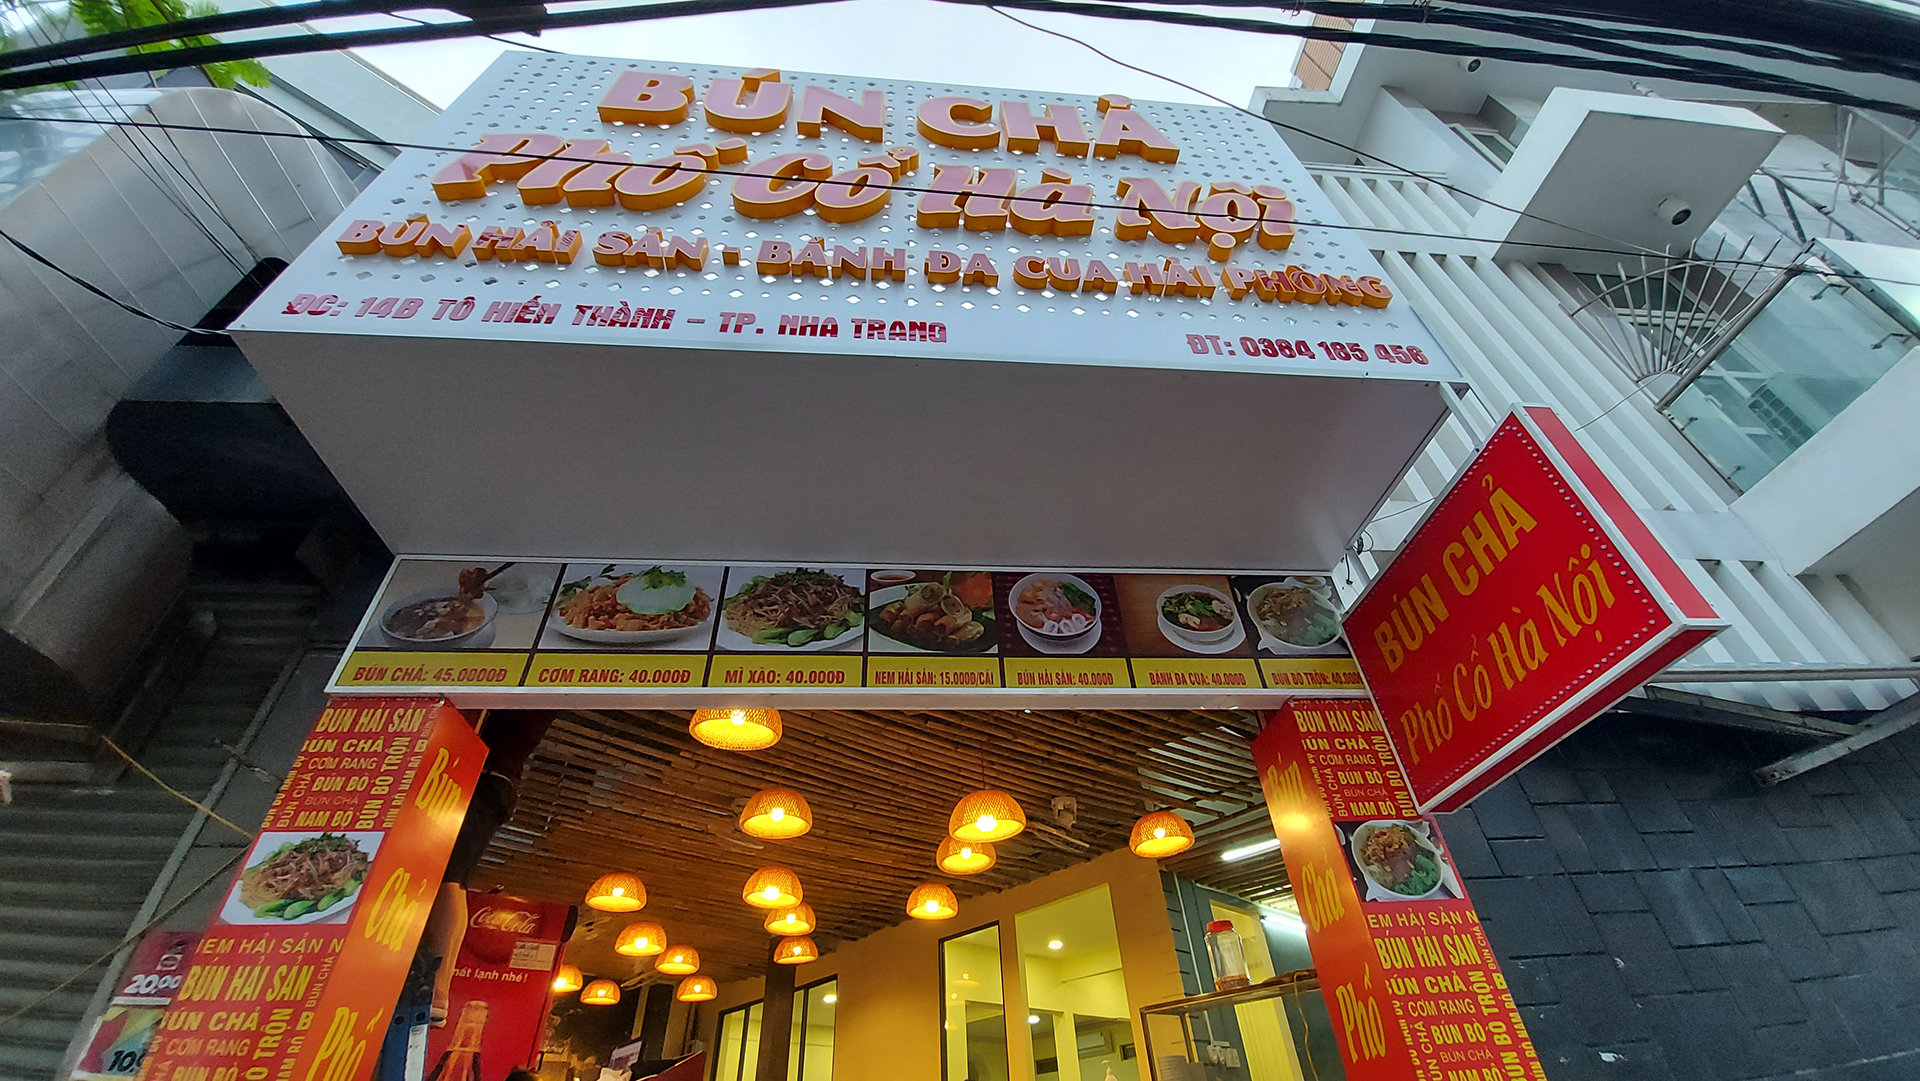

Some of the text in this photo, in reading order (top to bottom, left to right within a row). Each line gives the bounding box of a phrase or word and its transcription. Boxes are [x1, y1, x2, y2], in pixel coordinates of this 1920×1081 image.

[596, 68, 1180, 164] BÚN CHẢ
[430, 133, 1296, 262] Phố Cổ Hà Nội
[336, 214, 473, 258] BÚN
[471, 220, 583, 264] HẢI
[592, 226, 708, 271] SẢN
[756, 237, 906, 282] BÁNH
[925, 250, 999, 287] ĐA
[1013, 255, 1118, 293] CUA
[1123, 256, 1216, 299] HẢI
[1220, 265, 1393, 309] PHÒNG
[281, 293, 349, 316] ĐC:
[354, 296, 424, 319] 14B
[431, 296, 476, 321] TÔ
[481, 294, 562, 326] HIẾN
[571, 301, 677, 329] THÀNH
[719, 311, 764, 334] TP.
[778, 314, 838, 337] NHA
[851, 318, 947, 343] TRANG
[1186, 334, 1429, 365] ĐT: 0384 185 456
[1373, 473, 1538, 673] BÚN CHẢ
[1400, 544, 1616, 766] Phố Cổ Hà Nội
[352, 664, 388, 681] BÚN
[390, 664, 429, 682] CHẢ:
[538, 667, 691, 683] CƠM RANG: 40.000Đ
[724, 666, 845, 684] MÌ XÀO: 40.000Đ
[874, 671, 895, 685] NEM
[898, 668, 913, 685] HẢI
[916, 668, 937, 685] SẢN:
[1017, 669, 1114, 686] BÚN HẢI SẢN: 40.000Đ
[1188, 672, 1210, 685] CUA:
[1211, 672, 1247, 686] 40.000Đ
[315, 702, 357, 732] BÚN
[354, 702, 390, 732] HẢI
[388, 702, 426, 732] SẢN
[1294, 704, 1384, 733] BÚN HẢI SẢN
[342, 736, 386, 753] CHẢ
[1334, 735, 1370, 750] CHẢ
[308, 756, 340, 770] CƠM
[340, 757, 378, 770] RANG
[1320, 754, 1344, 765] CƠM
[1345, 754, 1376, 765] RANG
[311, 772, 344, 792] BÚN
[346, 773, 370, 792] BÒ
[355, 736, 412, 829] BÚN BÒ TRỘN
[415, 748, 462, 825] Bún
[1320, 768, 1338, 790] CHẢ
[1337, 768, 1364, 785] BÚN
[1365, 768, 1383, 785] BÒ
[1383, 771, 1405, 786] BÒ
[276, 801, 300, 828] BÚN
[292, 772, 314, 798] CHẢ
[1332, 794, 1348, 816] BÚN
[1350, 802, 1378, 816] NAM
[1379, 799, 1396, 818] BỘ
[1394, 791, 1417, 817] BÚN
[294, 811, 331, 827] NAM
[330, 808, 354, 830] BỘ
[1302, 846, 1345, 933] Chả
[365, 867, 427, 952] Chả
[1398, 907, 1425, 927] HẢI
[1430, 906, 1463, 925] SẢN
[239, 933, 275, 954] HẢI
[280, 932, 323, 954] SẢN
[1374, 926, 1481, 969] BÚN HẢI SẢN
[1471, 926, 1496, 969] BÚN CHẢ
[179, 954, 315, 1002] BÚN HẢI SẢN
[305, 956, 335, 1007] BÚN CHẢ
[474, 968, 499, 981] lạnh
[502, 971, 528, 983] nhé!
[1424, 970, 1467, 993] CHẢ
[1468, 971, 1499, 1016] TRỘN
[208, 1006, 260, 1031] CHẢ
[1335, 962, 1386, 1064] Phố
[1408, 999, 1438, 1017] CƠM
[1439, 998, 1475, 1016] RANG
[253, 1008, 294, 1060] TRỘN
[1410, 1021, 1433, 1053] CHẢ
[1431, 1020, 1463, 1045] BÚN
[1464, 1018, 1486, 1042] BÒ
[1486, 1021, 1512, 1045] BÒ
[205, 1038, 250, 1056] RANG
[1440, 1046, 1495, 1063] BÚN CHẢ
[1427, 1059, 1443, 1081] ÚN
